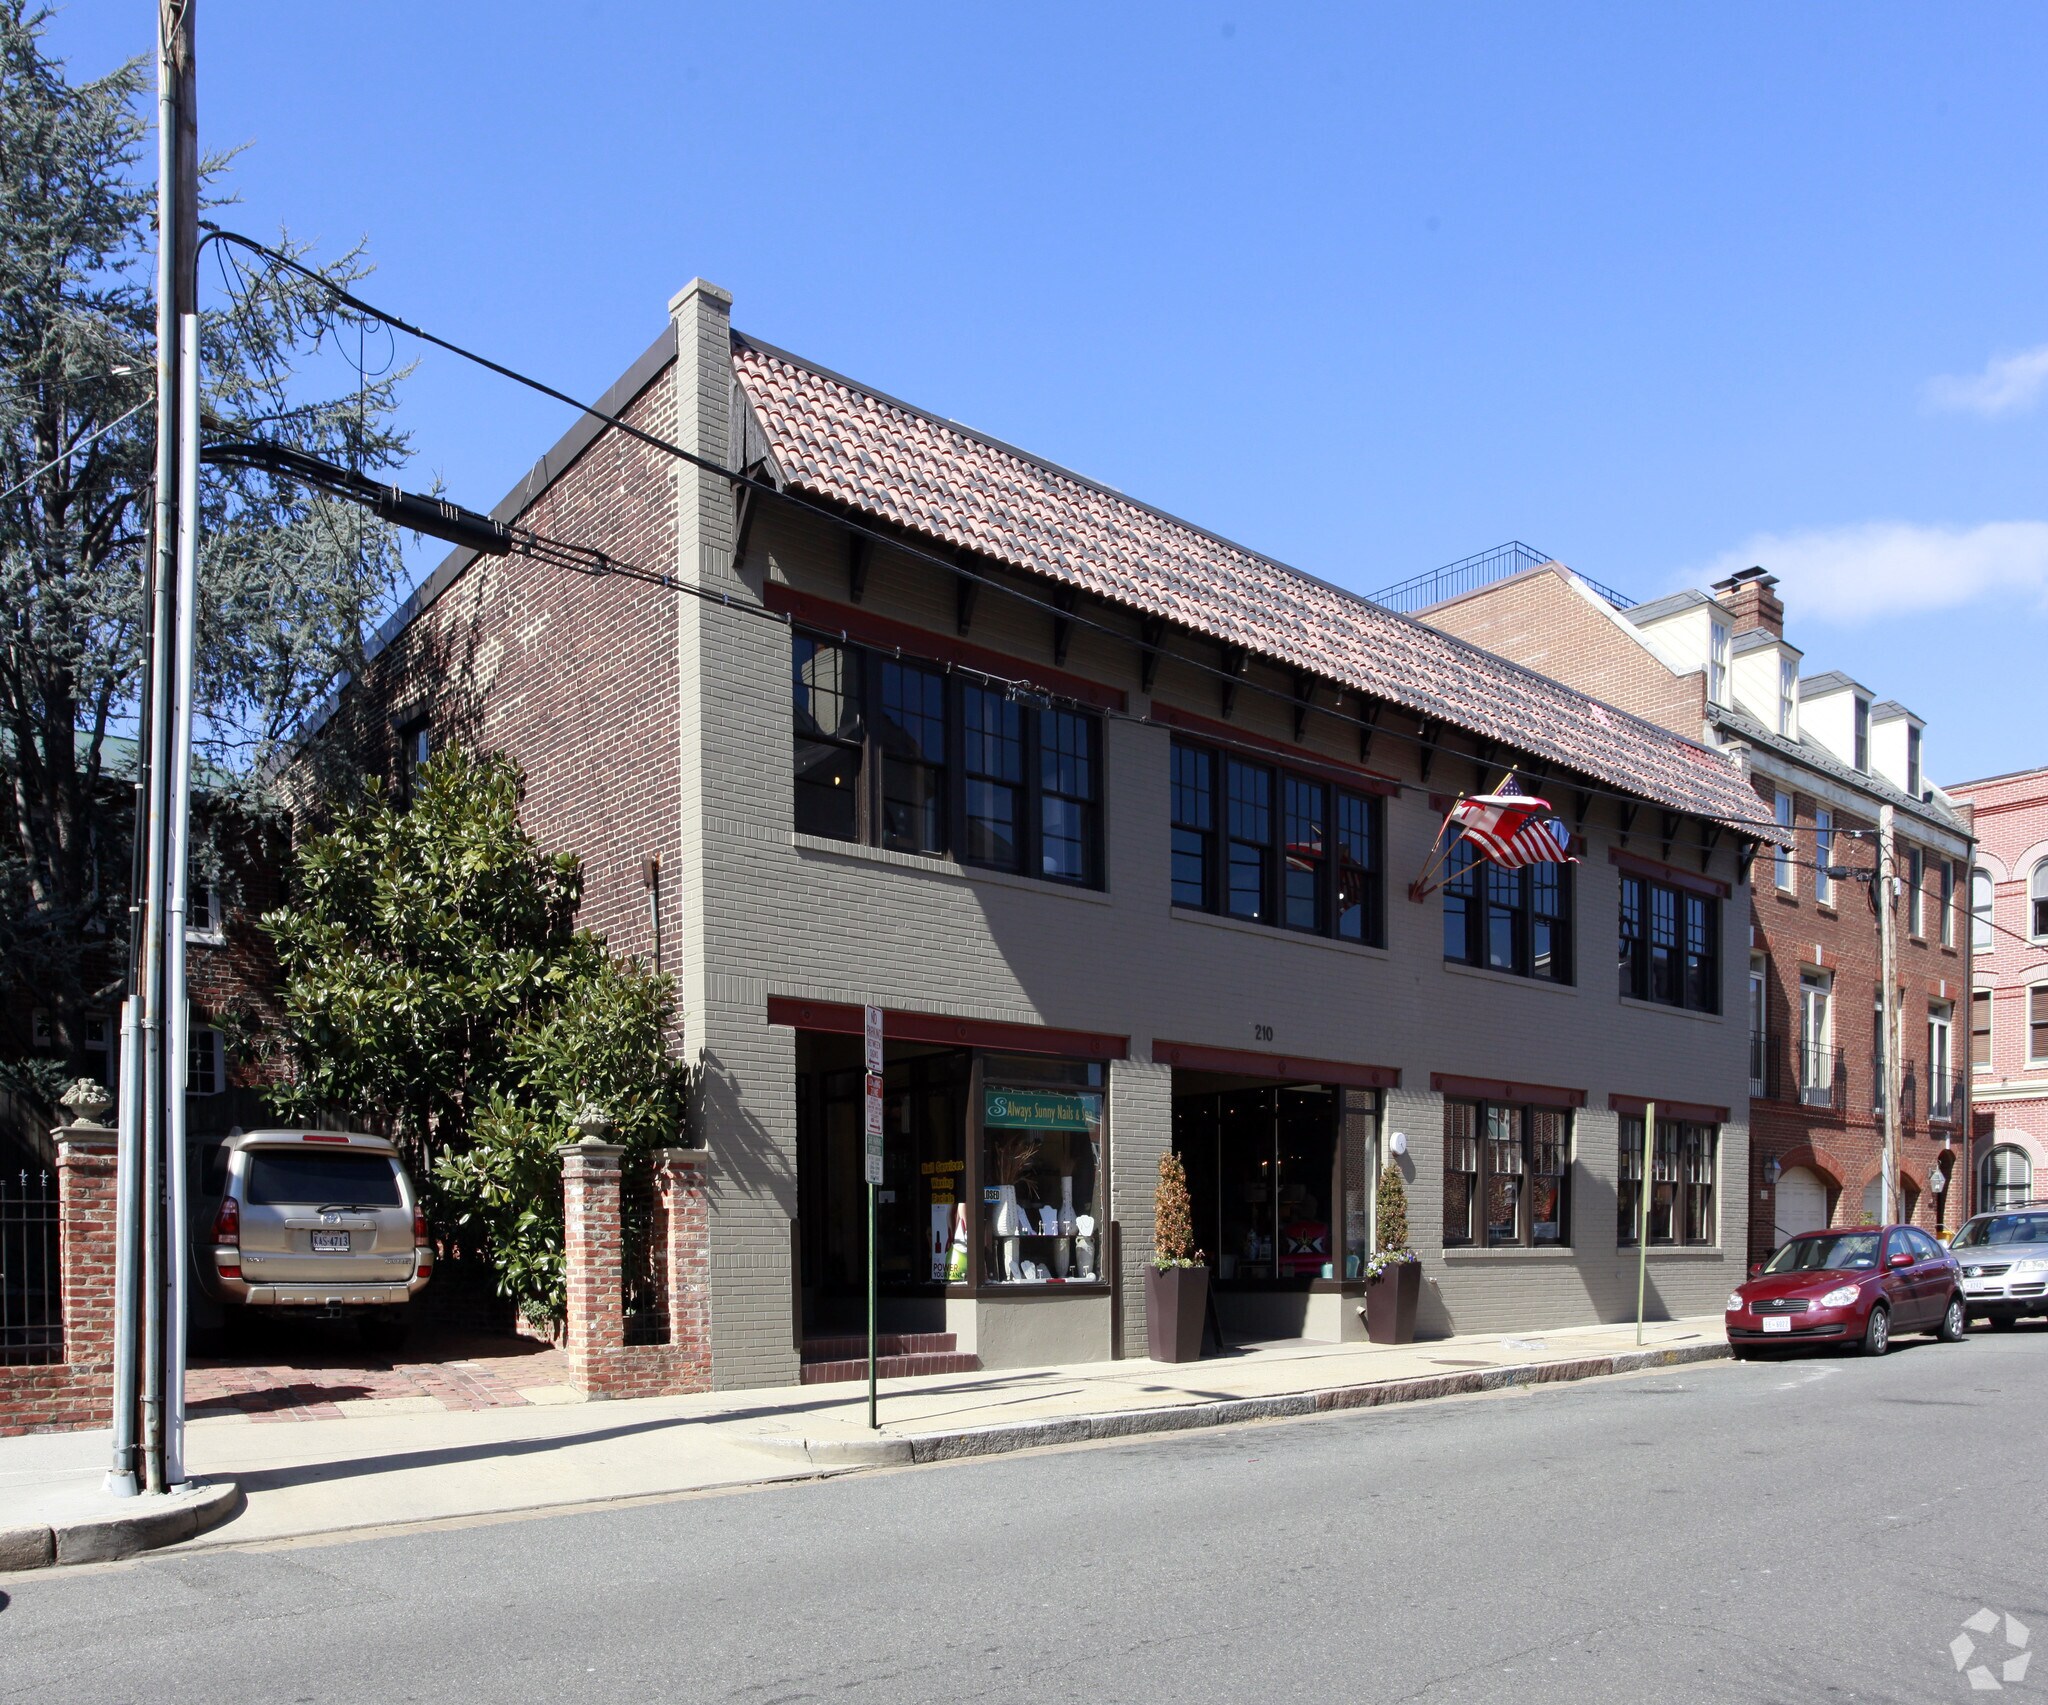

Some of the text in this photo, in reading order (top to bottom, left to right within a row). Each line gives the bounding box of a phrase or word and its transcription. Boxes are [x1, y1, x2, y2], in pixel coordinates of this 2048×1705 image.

[1255, 1024, 1273, 1041] 210
[1007, 1101, 1032, 1122] Always
[1034, 1103, 1056, 1123] Sunny
[1058, 1105, 1074, 1120] Nails
[936, 1160, 964, 1173] Services
[931, 1177, 954, 1190] Waxing
[932, 1193, 955, 1204] Facials
[984, 1190, 1000, 1200] LOSED
[934, 1263, 959, 1272] POWER
